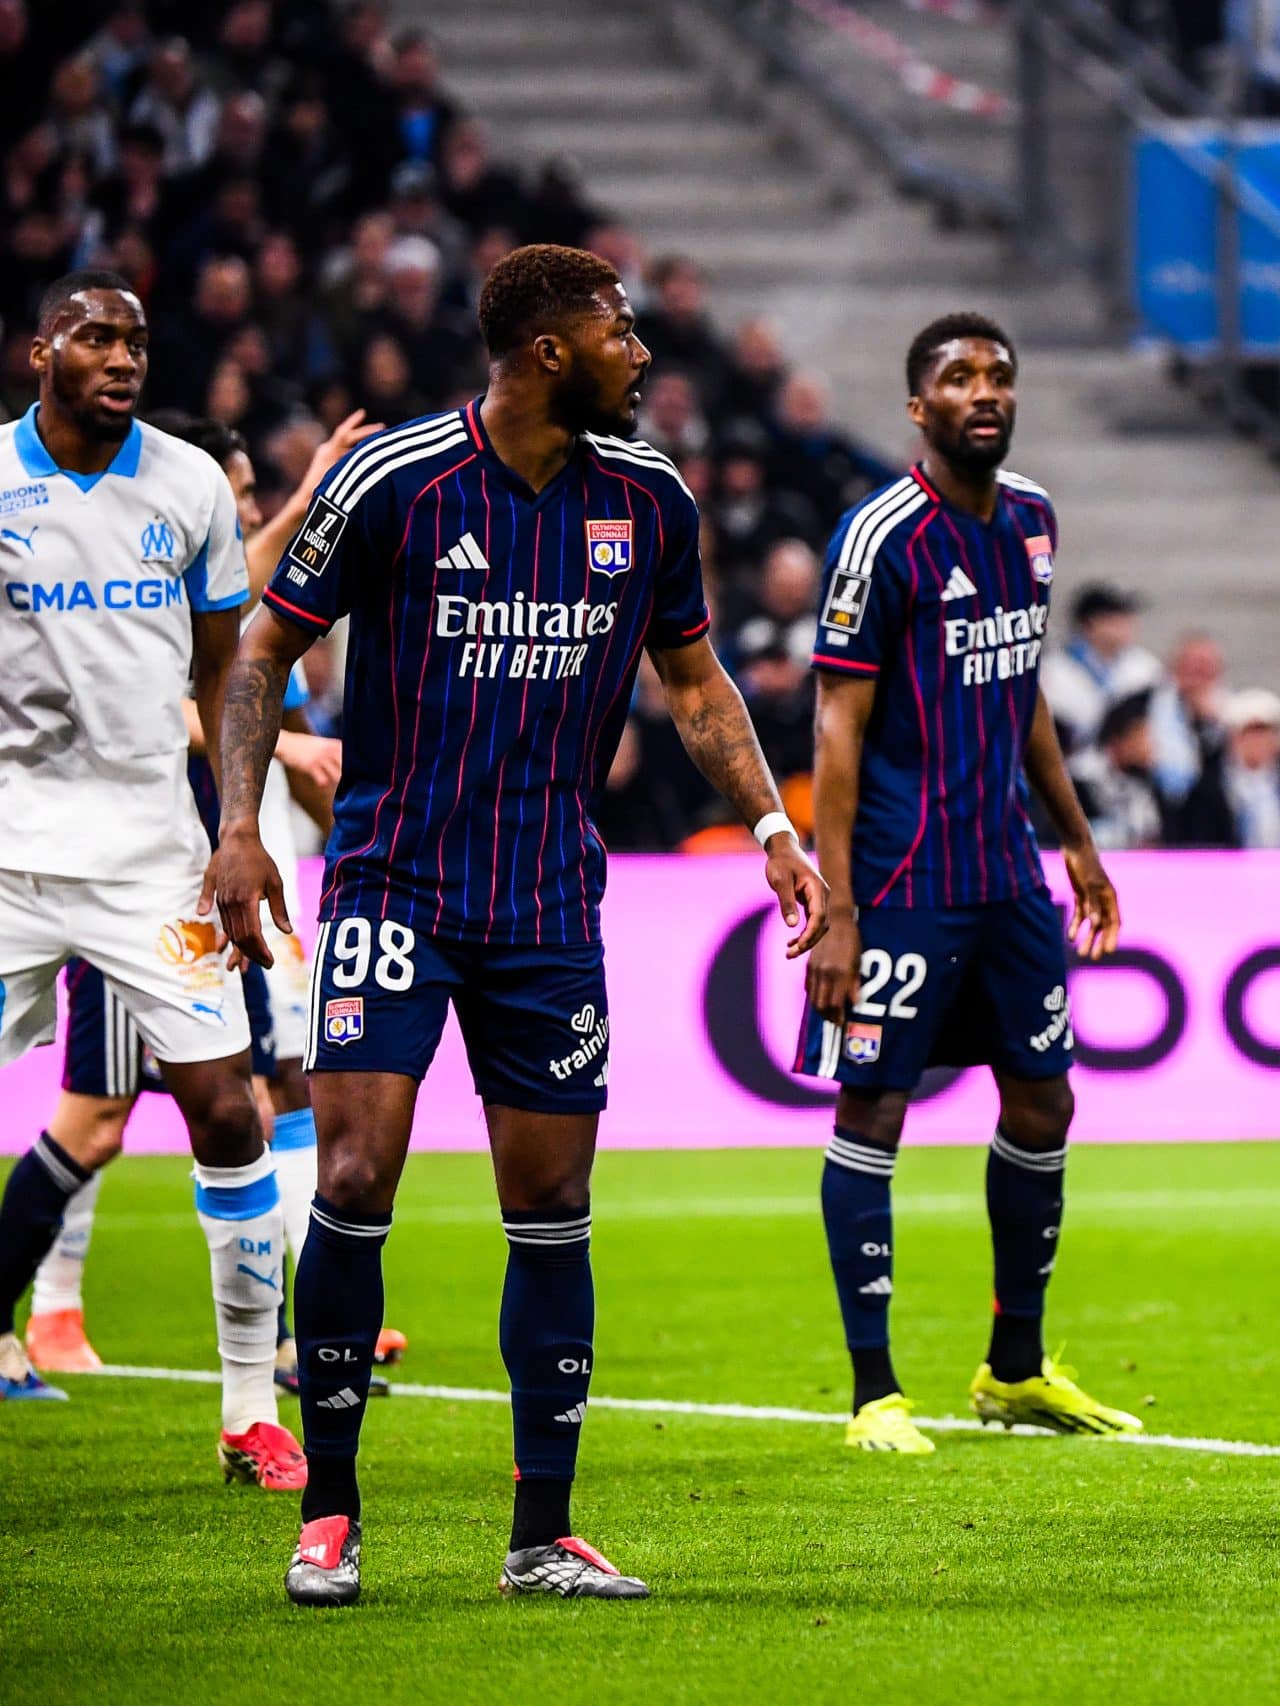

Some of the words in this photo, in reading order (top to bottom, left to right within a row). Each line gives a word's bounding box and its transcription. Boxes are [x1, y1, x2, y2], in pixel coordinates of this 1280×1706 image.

[0, 483, 48, 502] RIONS
[594, 543, 626, 566] OL
[6, 580, 97, 612] CMA
[104, 579, 182, 609] CGM
[436, 591, 617, 638] Emirates
[459, 643, 504, 678] FLY
[509, 643, 588, 680] BETTER
[963, 651, 995, 686] FLY
[332, 917, 415, 991] 98
[853, 949, 927, 1020] 22
[329, 1016, 360, 1037] OL
[239, 1237, 271, 1256] OM
[318, 1347, 358, 1363] OL
[557, 1358, 590, 1375] OL
